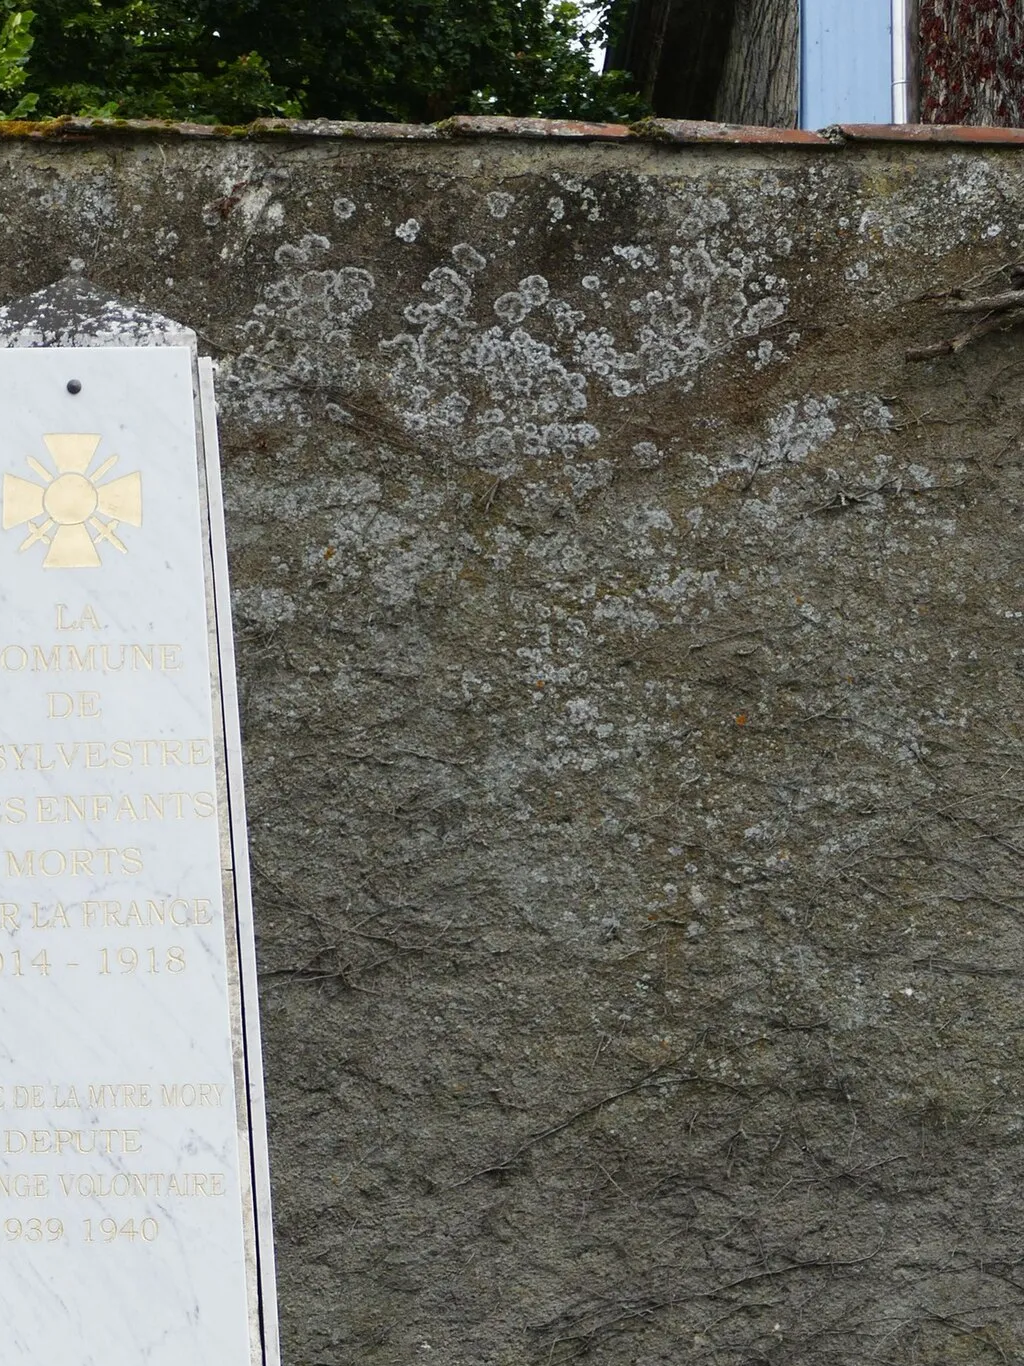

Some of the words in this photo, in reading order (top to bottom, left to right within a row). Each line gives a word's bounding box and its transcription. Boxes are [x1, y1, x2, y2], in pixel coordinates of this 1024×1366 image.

[56, 603, 102, 631] LA
[47, 691, 101, 719] DE
[36, 792, 215, 821] ENFANTS
[5, 848, 143, 878] MORTS
[31, 902, 70, 929] LA
[83, 899, 213, 928] FRANCE
[99, 946, 186, 975] 1918
[13, 1085, 48, 1109] DE
[52, 1085, 81, 1109] LA
[89, 1084, 152, 1109] MYRE
[160, 1083, 226, 1108] MORY
[3, 1129, 143, 1154] DEPUTE
[58, 1173, 226, 1197] VOLONTAIRE
[83, 1217, 160, 1242] 1940
